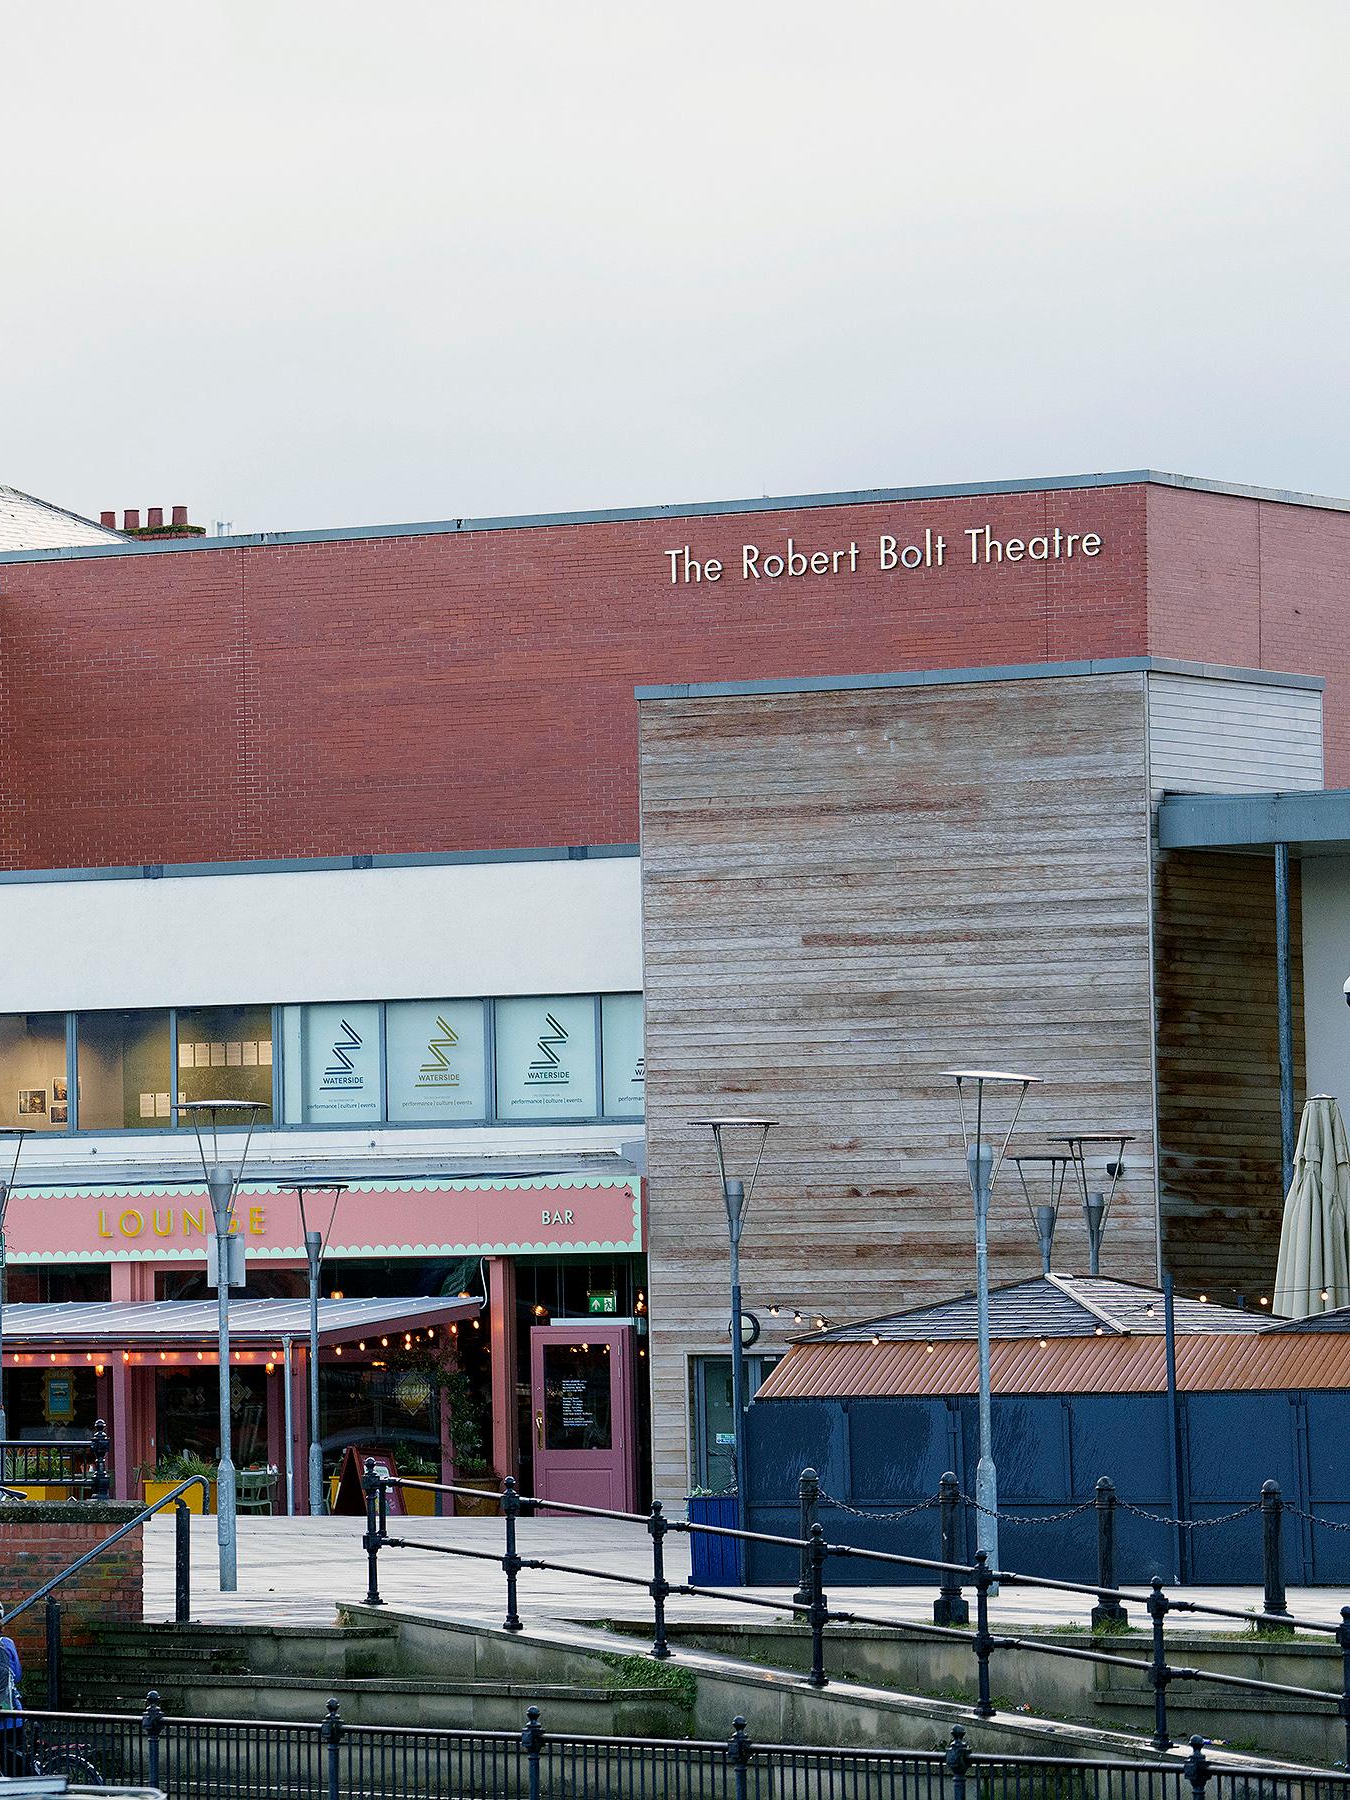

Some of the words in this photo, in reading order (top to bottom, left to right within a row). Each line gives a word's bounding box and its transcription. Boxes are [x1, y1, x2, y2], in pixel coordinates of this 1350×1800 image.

[664, 545, 723, 584] The
[742, 538, 859, 579] Robert
[880, 528, 947, 570] Bolt
[964, 524, 1101, 564] Theatre
[418, 1074, 460, 1082] WATERSIDE
[527, 1071, 570, 1079] WATERSIDE
[322, 1076, 364, 1085] WATERSIDE
[541, 1209, 575, 1226] BAR
